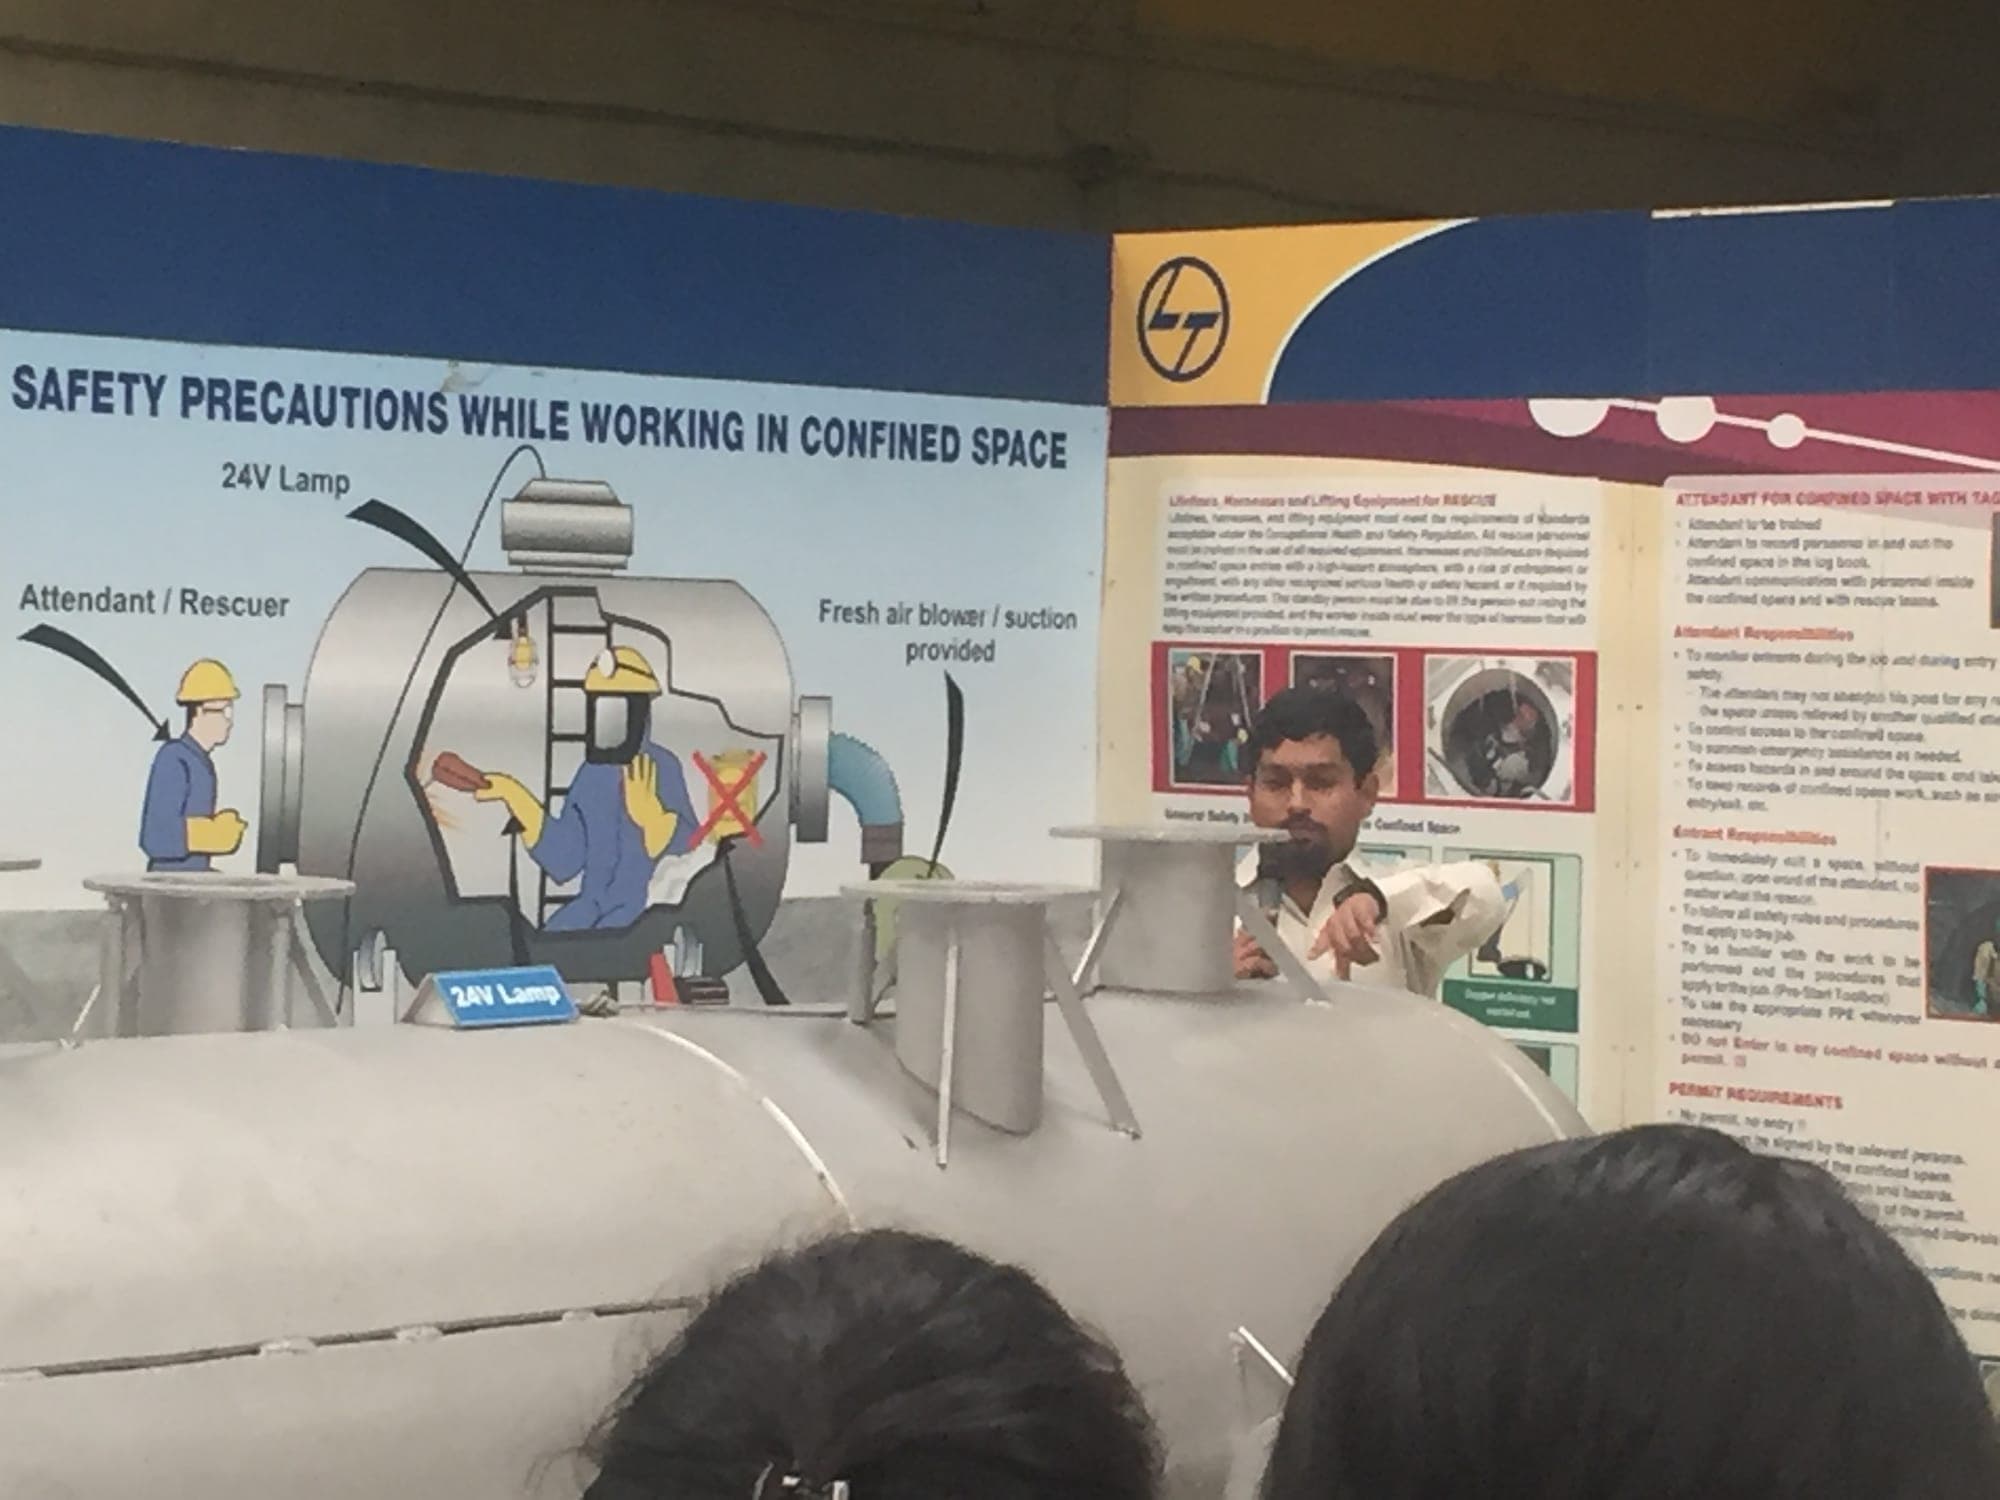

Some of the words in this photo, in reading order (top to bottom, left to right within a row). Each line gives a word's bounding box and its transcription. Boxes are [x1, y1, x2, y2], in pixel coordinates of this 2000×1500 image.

[12, 364, 168, 417] SAFETY
[180, 376, 448, 435] PRECAUTIONS
[459, 393, 570, 442] WHILE
[581, 401, 744, 452] WORKING
[757, 414, 788, 454] IN
[800, 416, 960, 464] CONFINED
[970, 426, 1068, 469] SPACE
[221, 461, 272, 492] 24V
[280, 466, 351, 497] Lamp
[1676, 492, 1757, 506] ATTENDANT
[1762, 492, 1791, 506] FOR
[1875, 491, 1922, 506] SPACE
[1927, 491, 1967, 505] WITH
[20, 583, 157, 615] Attendant
[180, 588, 290, 618] Rescuer
[819, 599, 880, 625] Fresh
[886, 601, 914, 626] air
[919, 603, 986, 630] blower
[1004, 607, 1077, 631] suction
[905, 638, 996, 666] provided
[450, 984, 494, 1007] 24V
[500, 983, 562, 1006] Lamp
